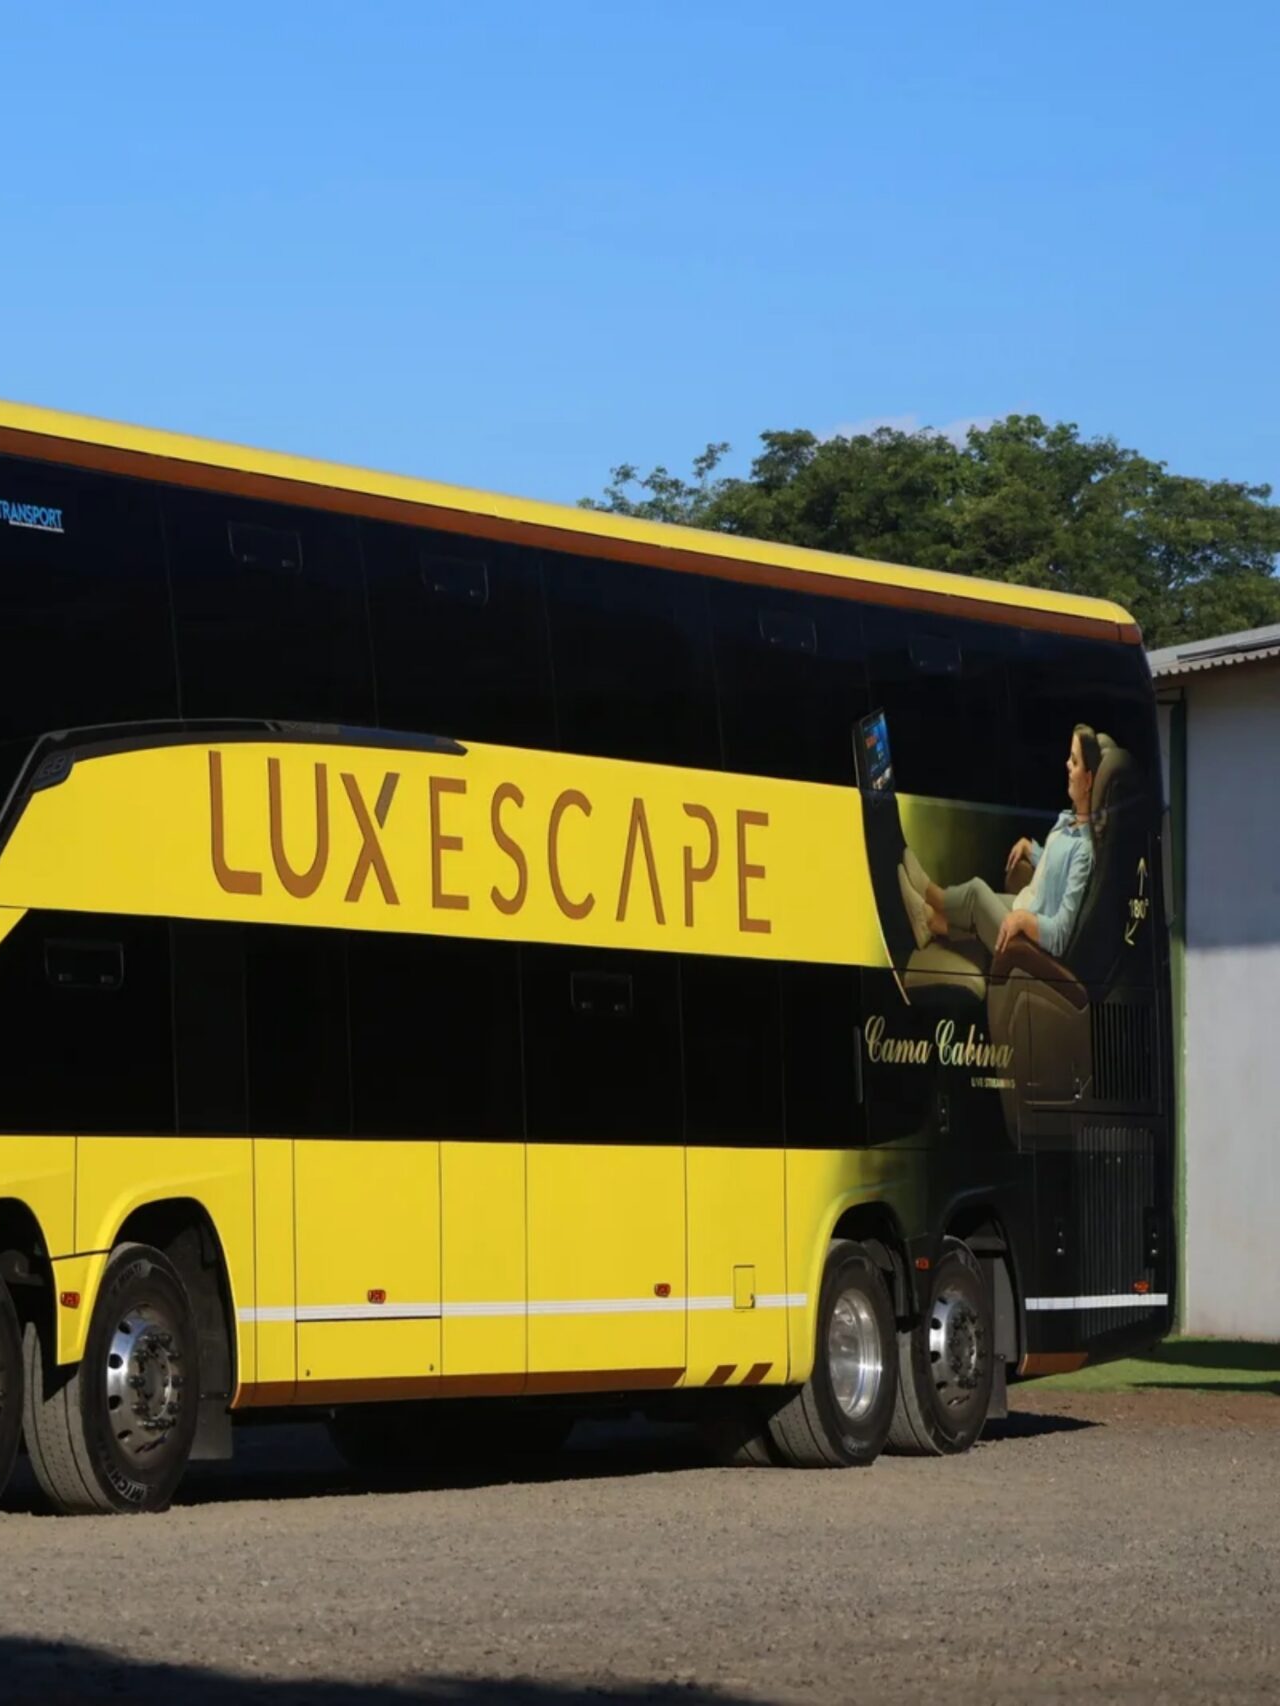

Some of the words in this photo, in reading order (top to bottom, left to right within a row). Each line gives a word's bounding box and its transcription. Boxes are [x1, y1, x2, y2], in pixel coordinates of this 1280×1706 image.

[209, 750, 772, 934] LUXESCAPE
[864, 1015, 933, 1064] Cama
[935, 1019, 1014, 1068] Cabina
